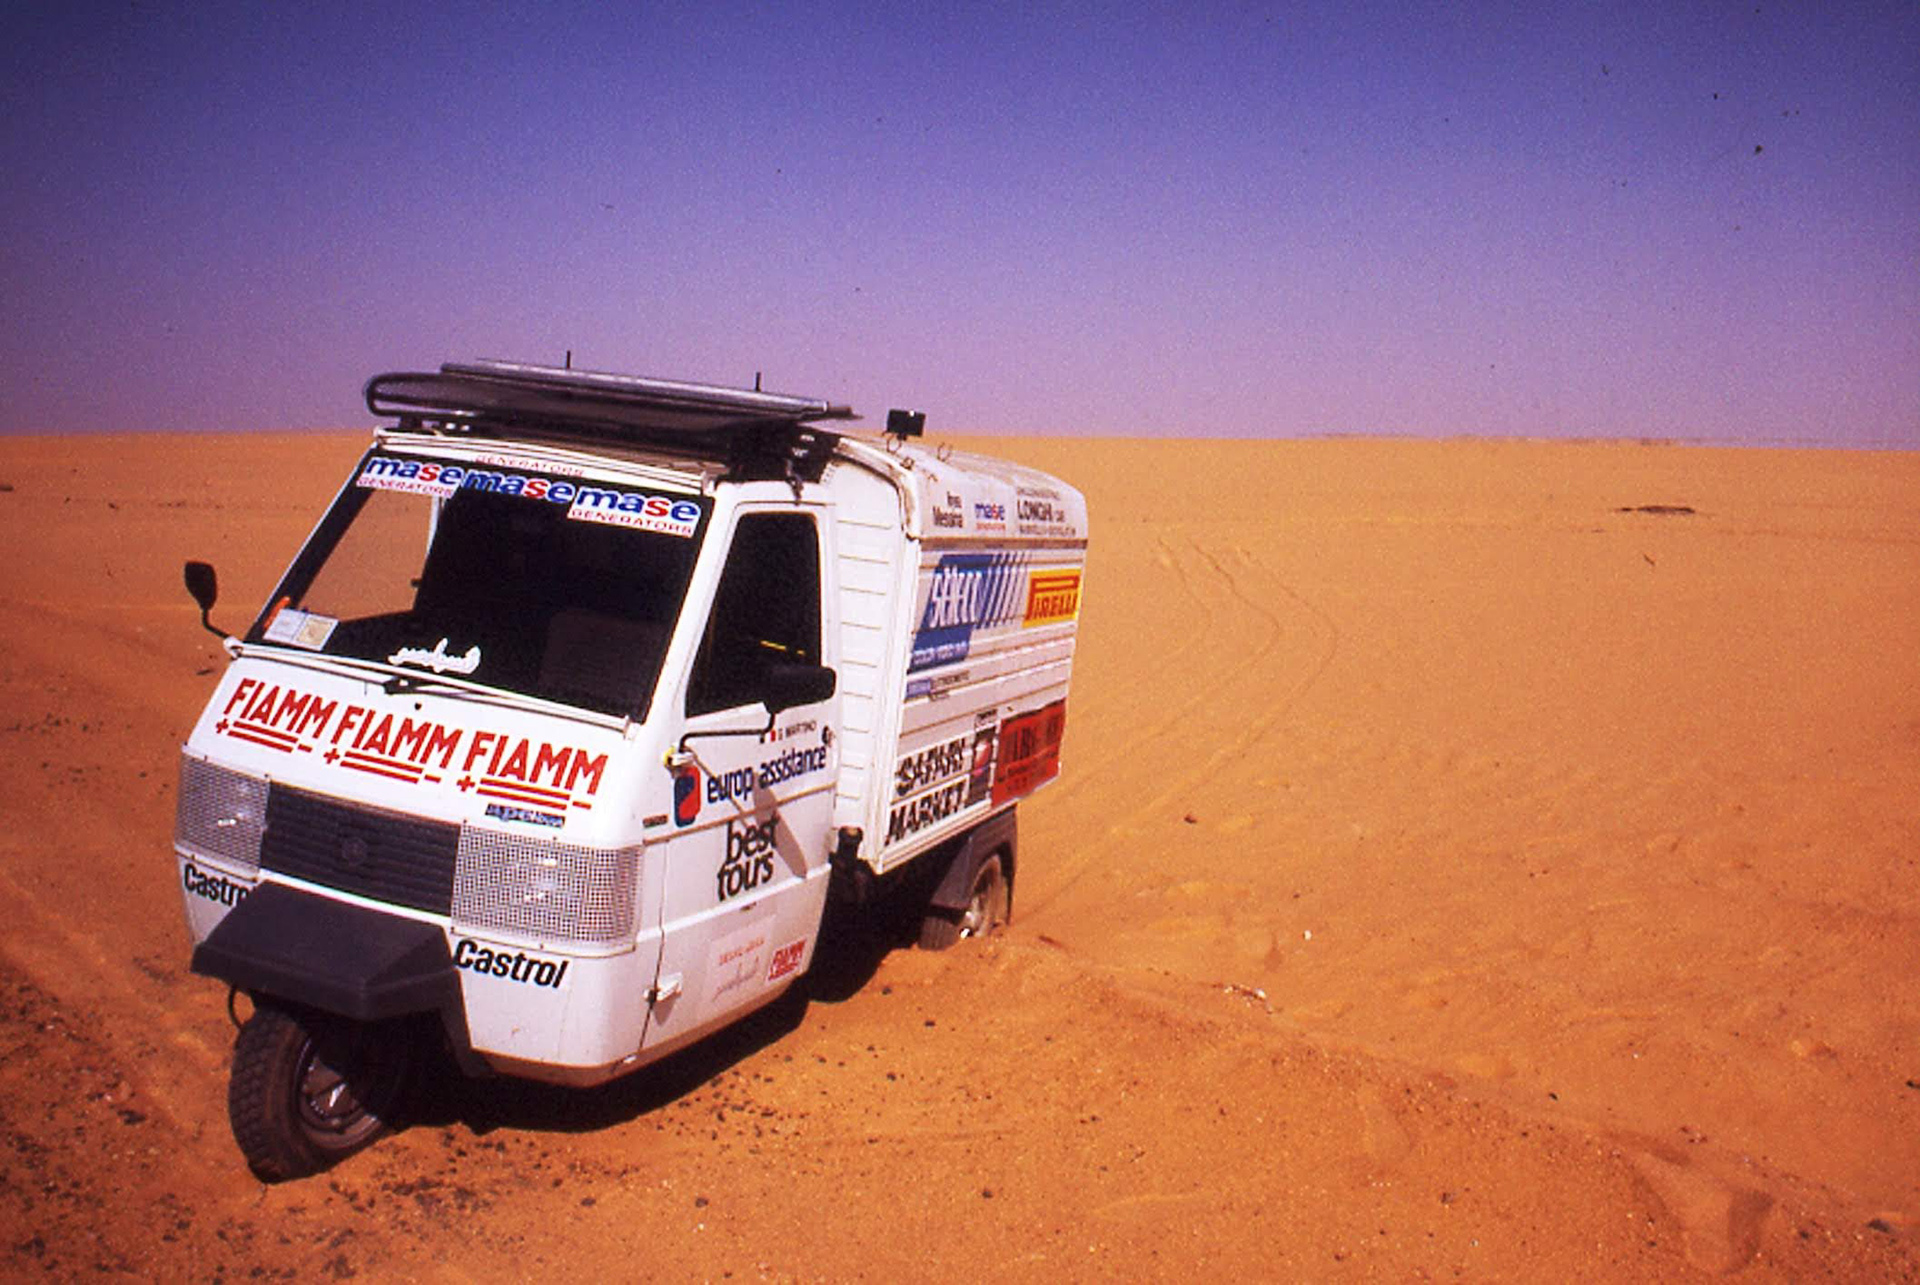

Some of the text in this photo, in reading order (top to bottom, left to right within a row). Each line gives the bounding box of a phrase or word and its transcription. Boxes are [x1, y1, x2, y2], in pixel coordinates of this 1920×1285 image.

[366, 457, 700, 522] mase mase mase
[974, 502, 1006, 520] mase
[569, 508, 694, 535] GENERATORS
[1025, 575, 1082, 621] PIRELLI
[223, 678, 609, 796] FIAMM FIAMM FIAMM
[706, 747, 827, 804] europ assistance
[884, 778, 966, 847] MARKET
[725, 816, 779, 864] best
[184, 863, 249, 907] Castro
[716, 851, 774, 902] tours
[454, 939, 570, 989] Castrol
